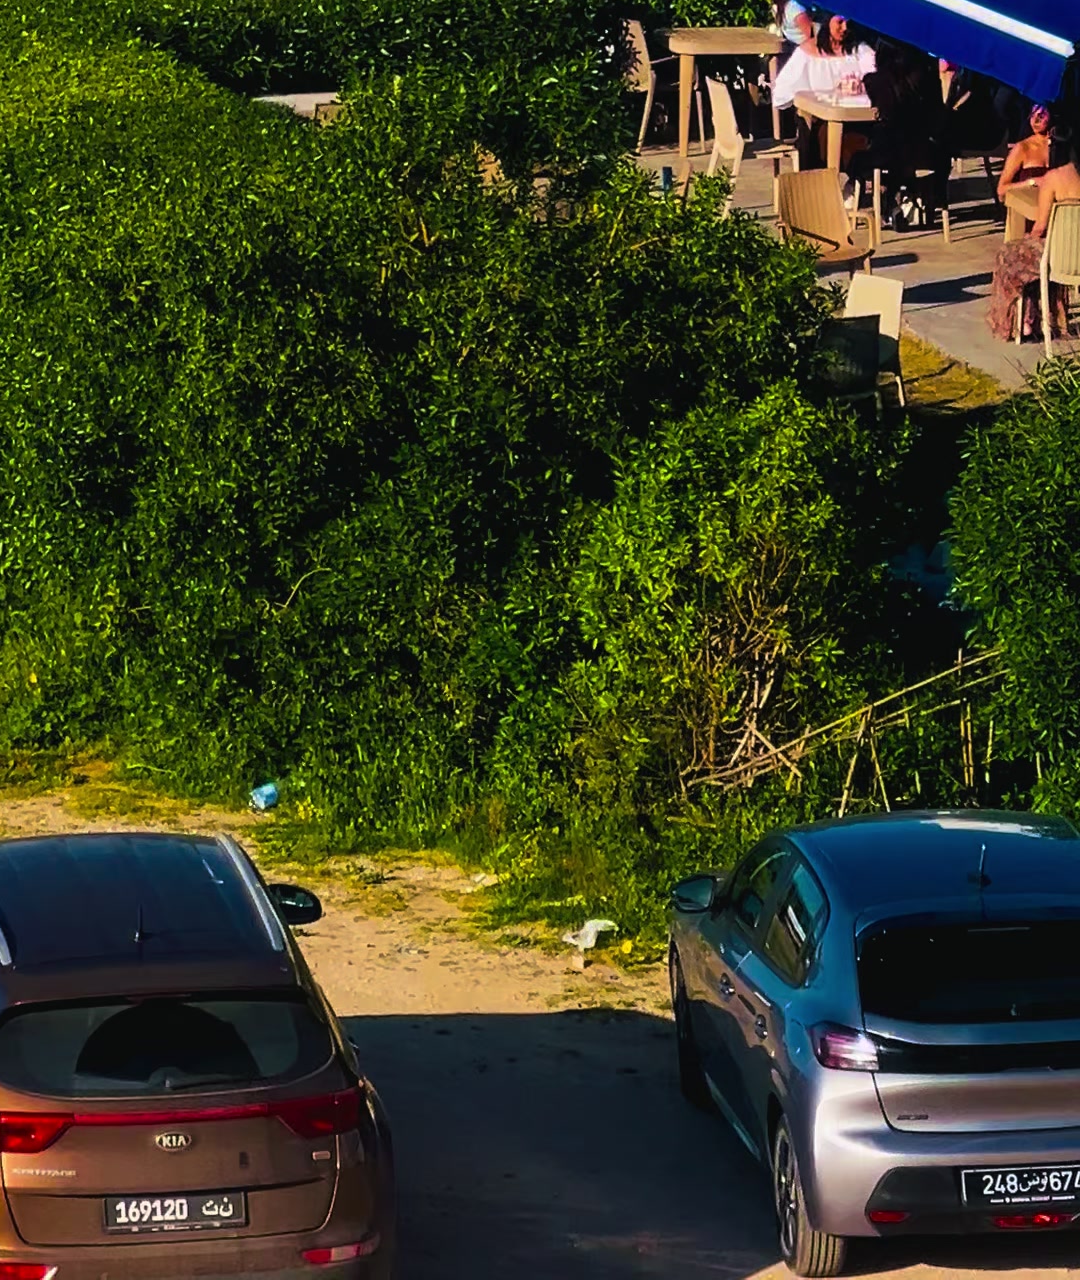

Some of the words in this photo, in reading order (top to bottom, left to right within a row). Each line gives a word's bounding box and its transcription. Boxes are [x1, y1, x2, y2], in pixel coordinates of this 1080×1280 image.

[162, 1135, 187, 1147] KIA
[982, 1174, 1018, 1195] 248
[115, 1198, 188, 1223] 169120
